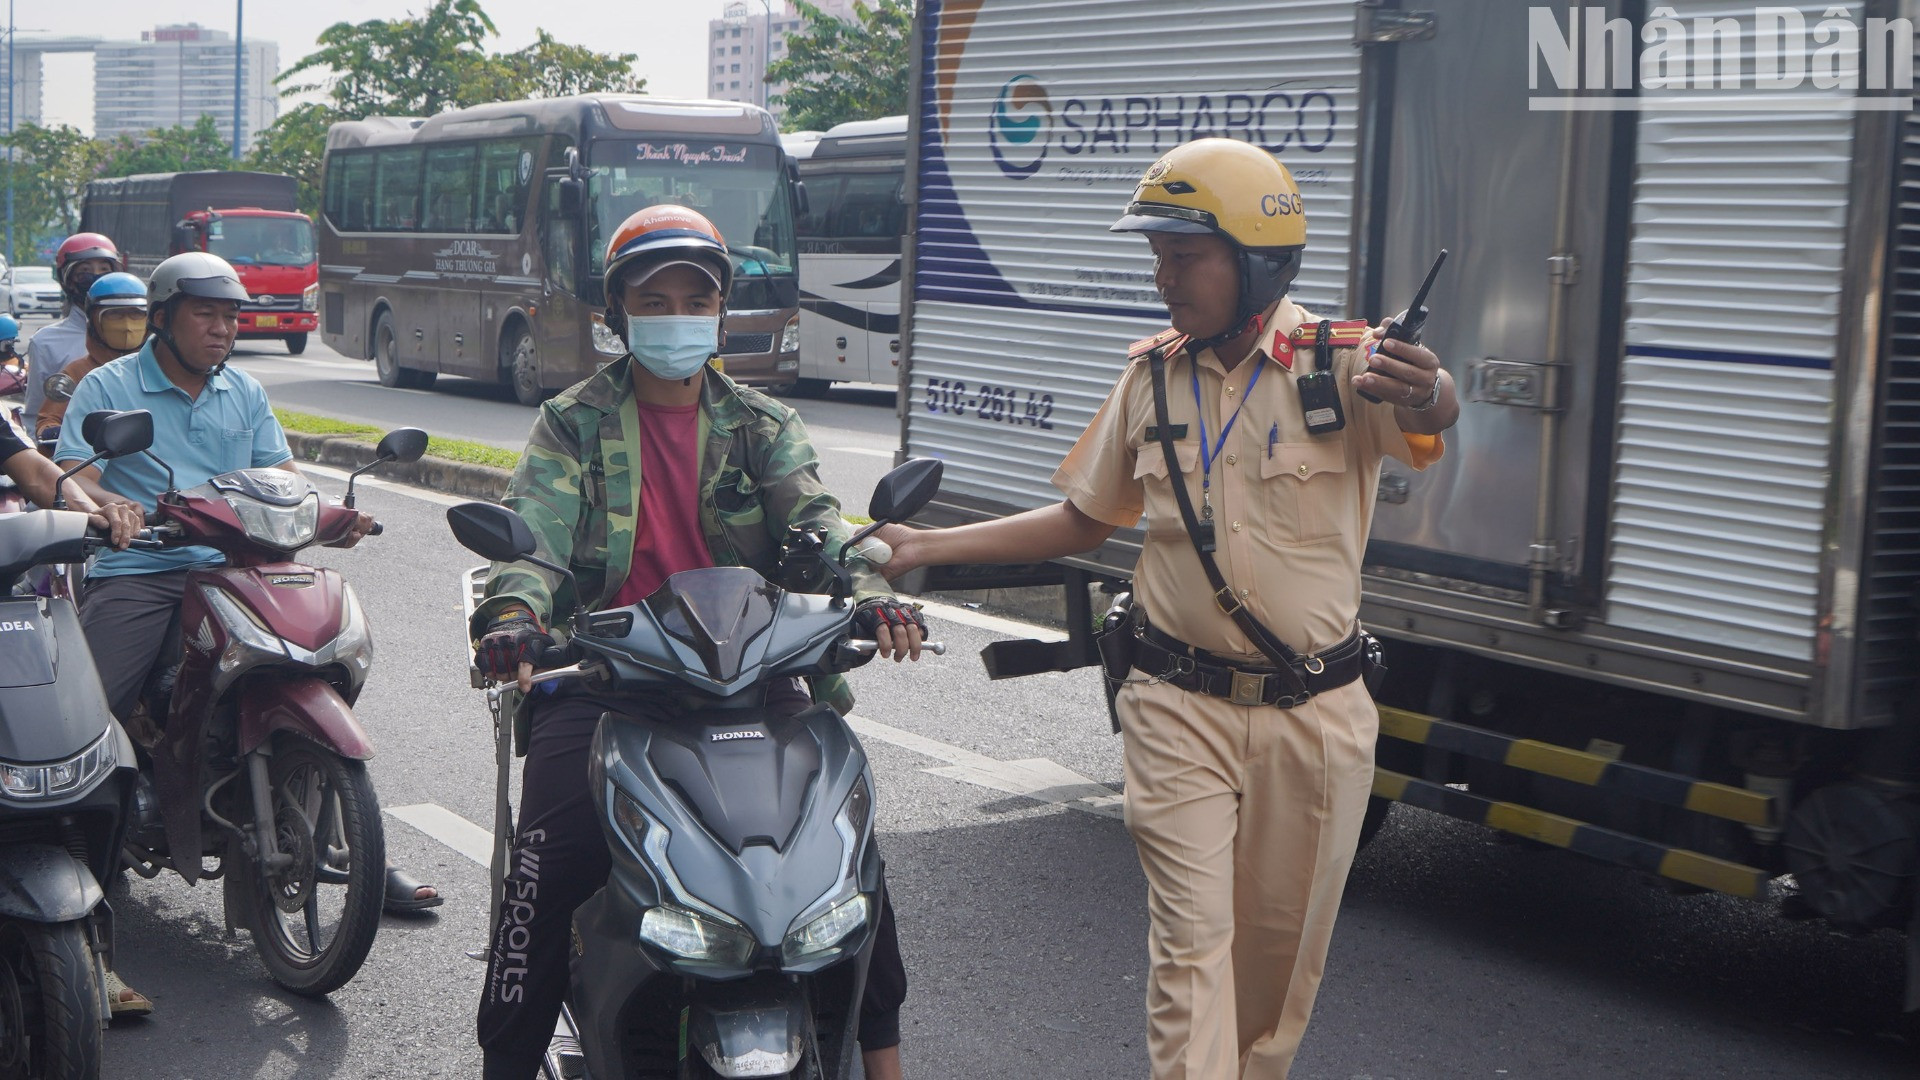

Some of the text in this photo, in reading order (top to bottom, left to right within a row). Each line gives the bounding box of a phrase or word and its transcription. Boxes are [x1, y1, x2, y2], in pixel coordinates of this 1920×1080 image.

[1061, 91, 1337, 154] SAPHARCO
[636, 143, 670, 160] Thanh
[1260, 193, 1304, 217] CSG
[643, 215, 692, 227] Ahamove
[453, 240, 478, 256] DCAR
[484, 260, 496, 273] GIA
[184, 634, 211, 659] HONDA
[711, 730, 765, 742] HONDA
